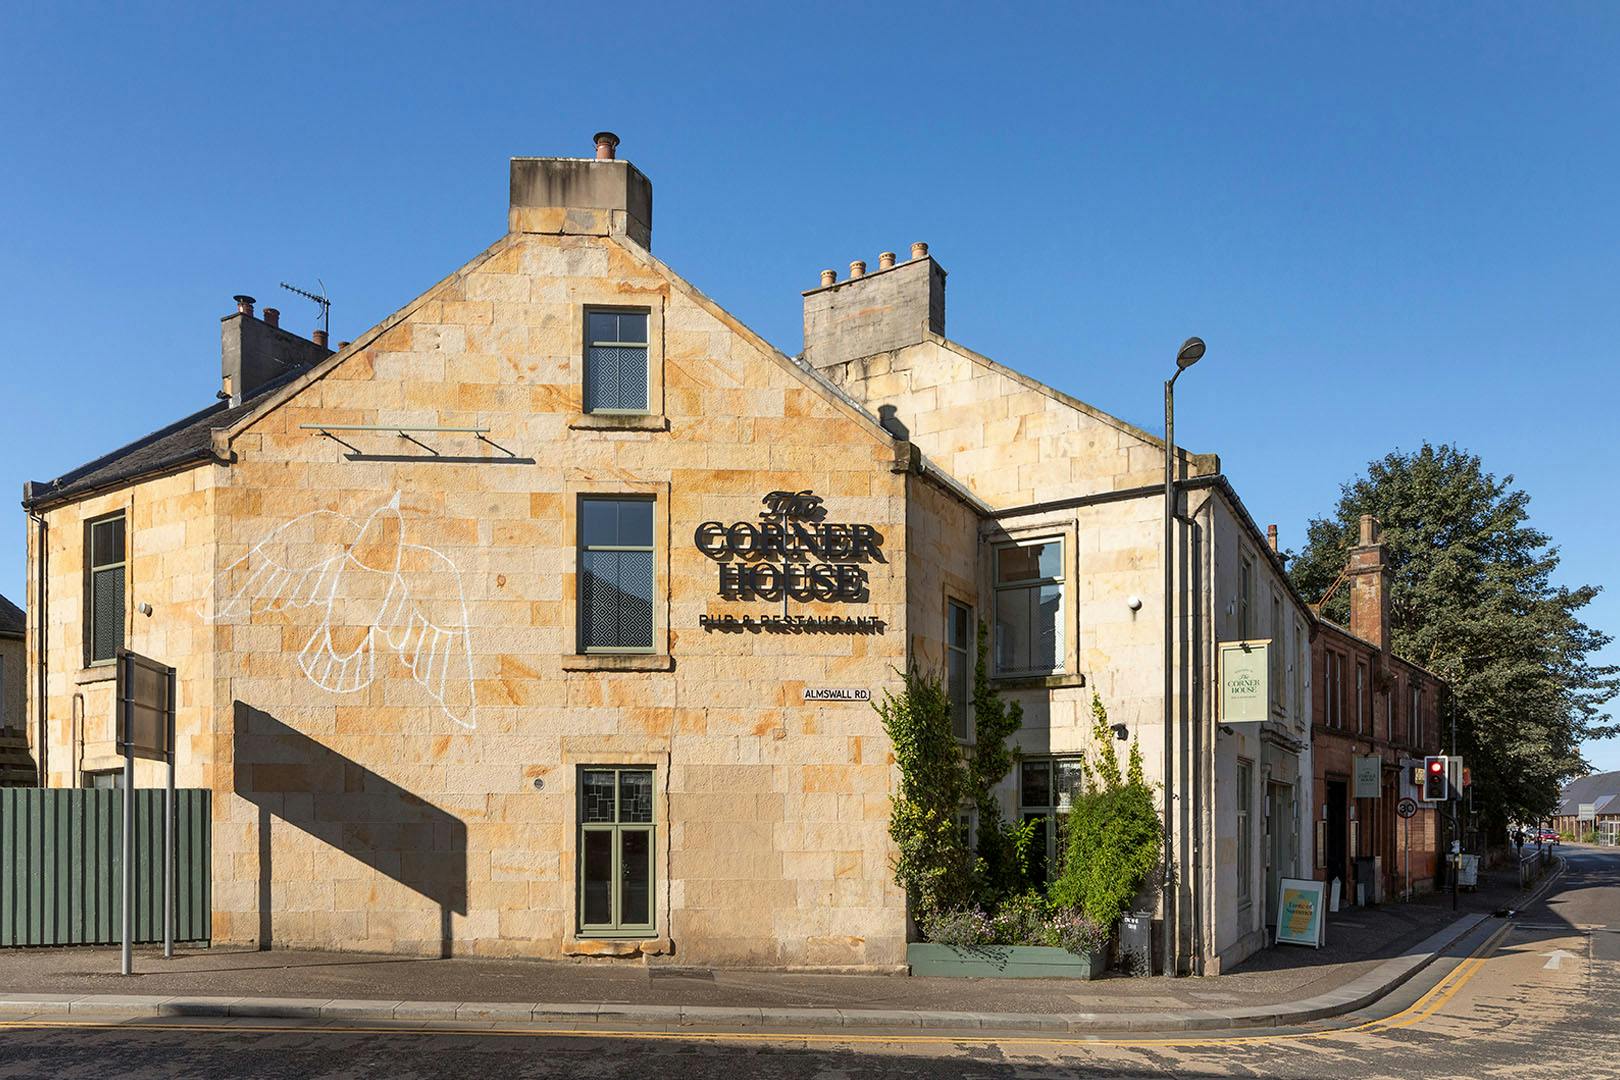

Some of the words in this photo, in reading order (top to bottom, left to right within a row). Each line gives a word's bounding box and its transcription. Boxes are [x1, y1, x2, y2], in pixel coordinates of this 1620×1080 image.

[759, 490, 825, 519] The
[694, 521, 887, 561] CORNER
[716, 562, 862, 598] HOUSE
[761, 614, 880, 629] RESTAURANT
[1227, 679, 1260, 688] CORNER
[804, 689, 852, 699] ALMSWALL
[1231, 686, 1258, 694] HOUSE
[1399, 803, 1413, 812] 30
